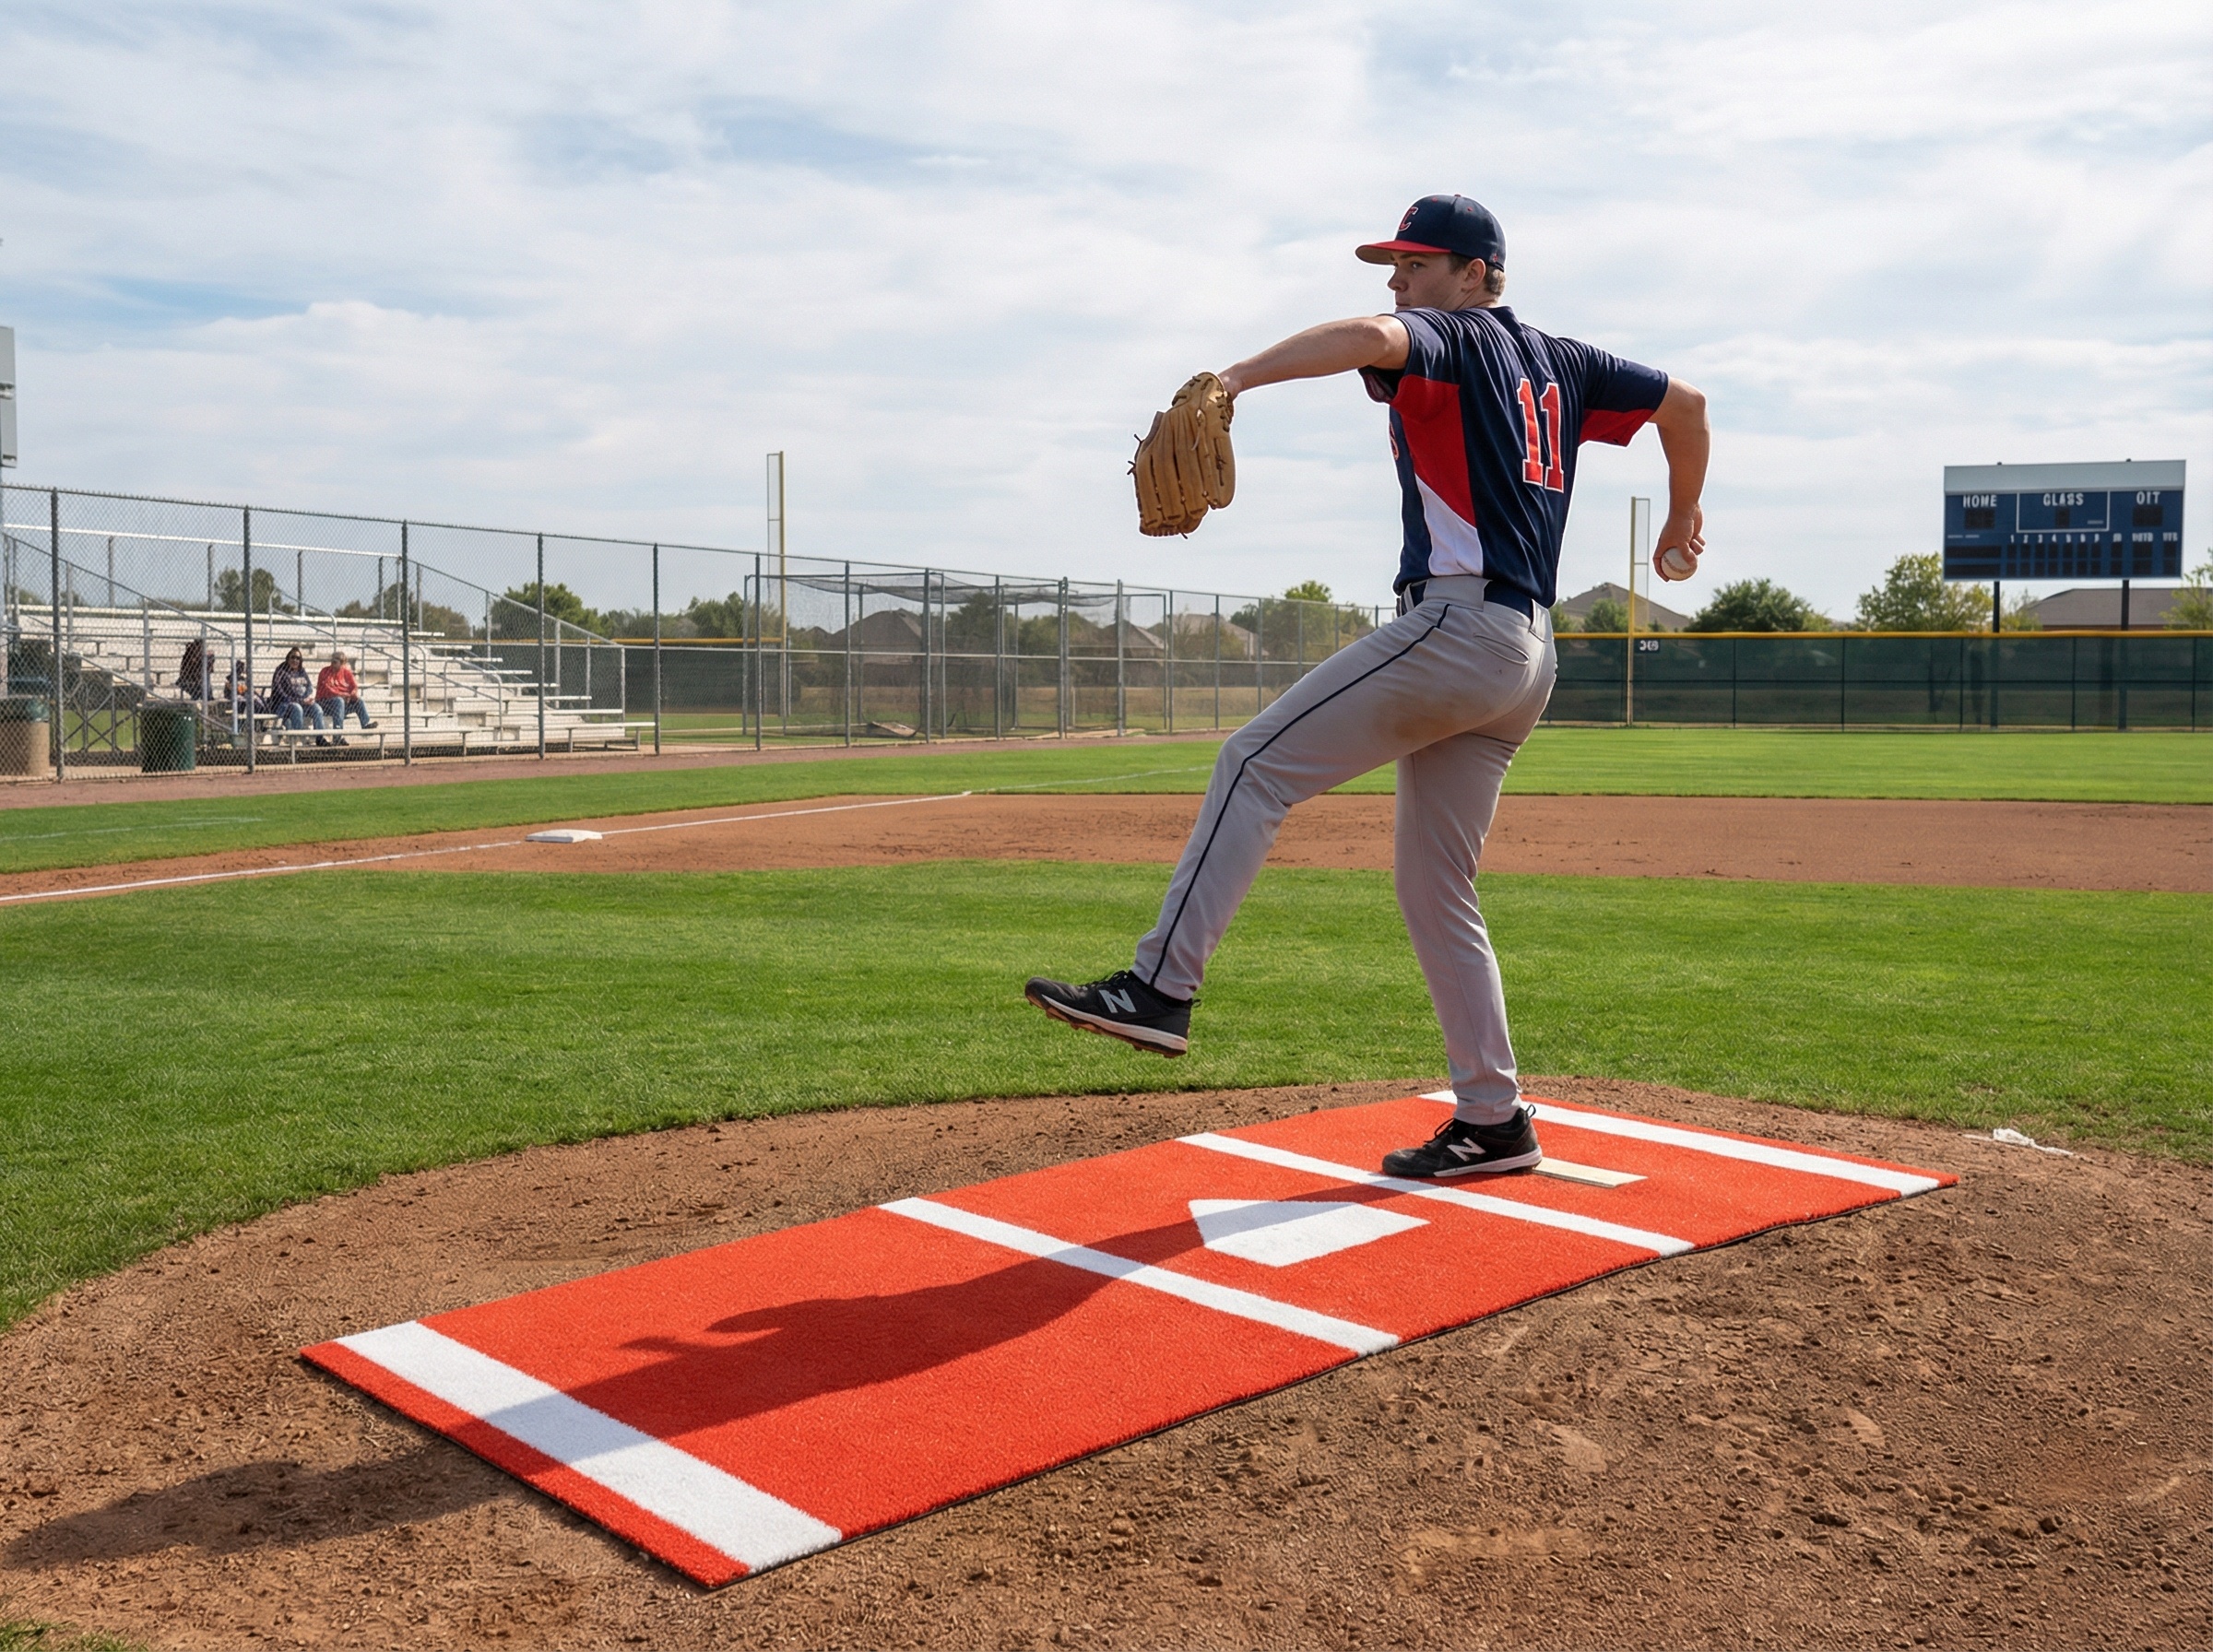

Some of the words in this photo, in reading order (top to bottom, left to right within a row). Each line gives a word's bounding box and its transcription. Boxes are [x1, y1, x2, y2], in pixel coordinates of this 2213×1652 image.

[1398, 206, 1419, 231] C
[1517, 378, 1564, 493] 11
[1962, 494, 1997, 508] HOME
